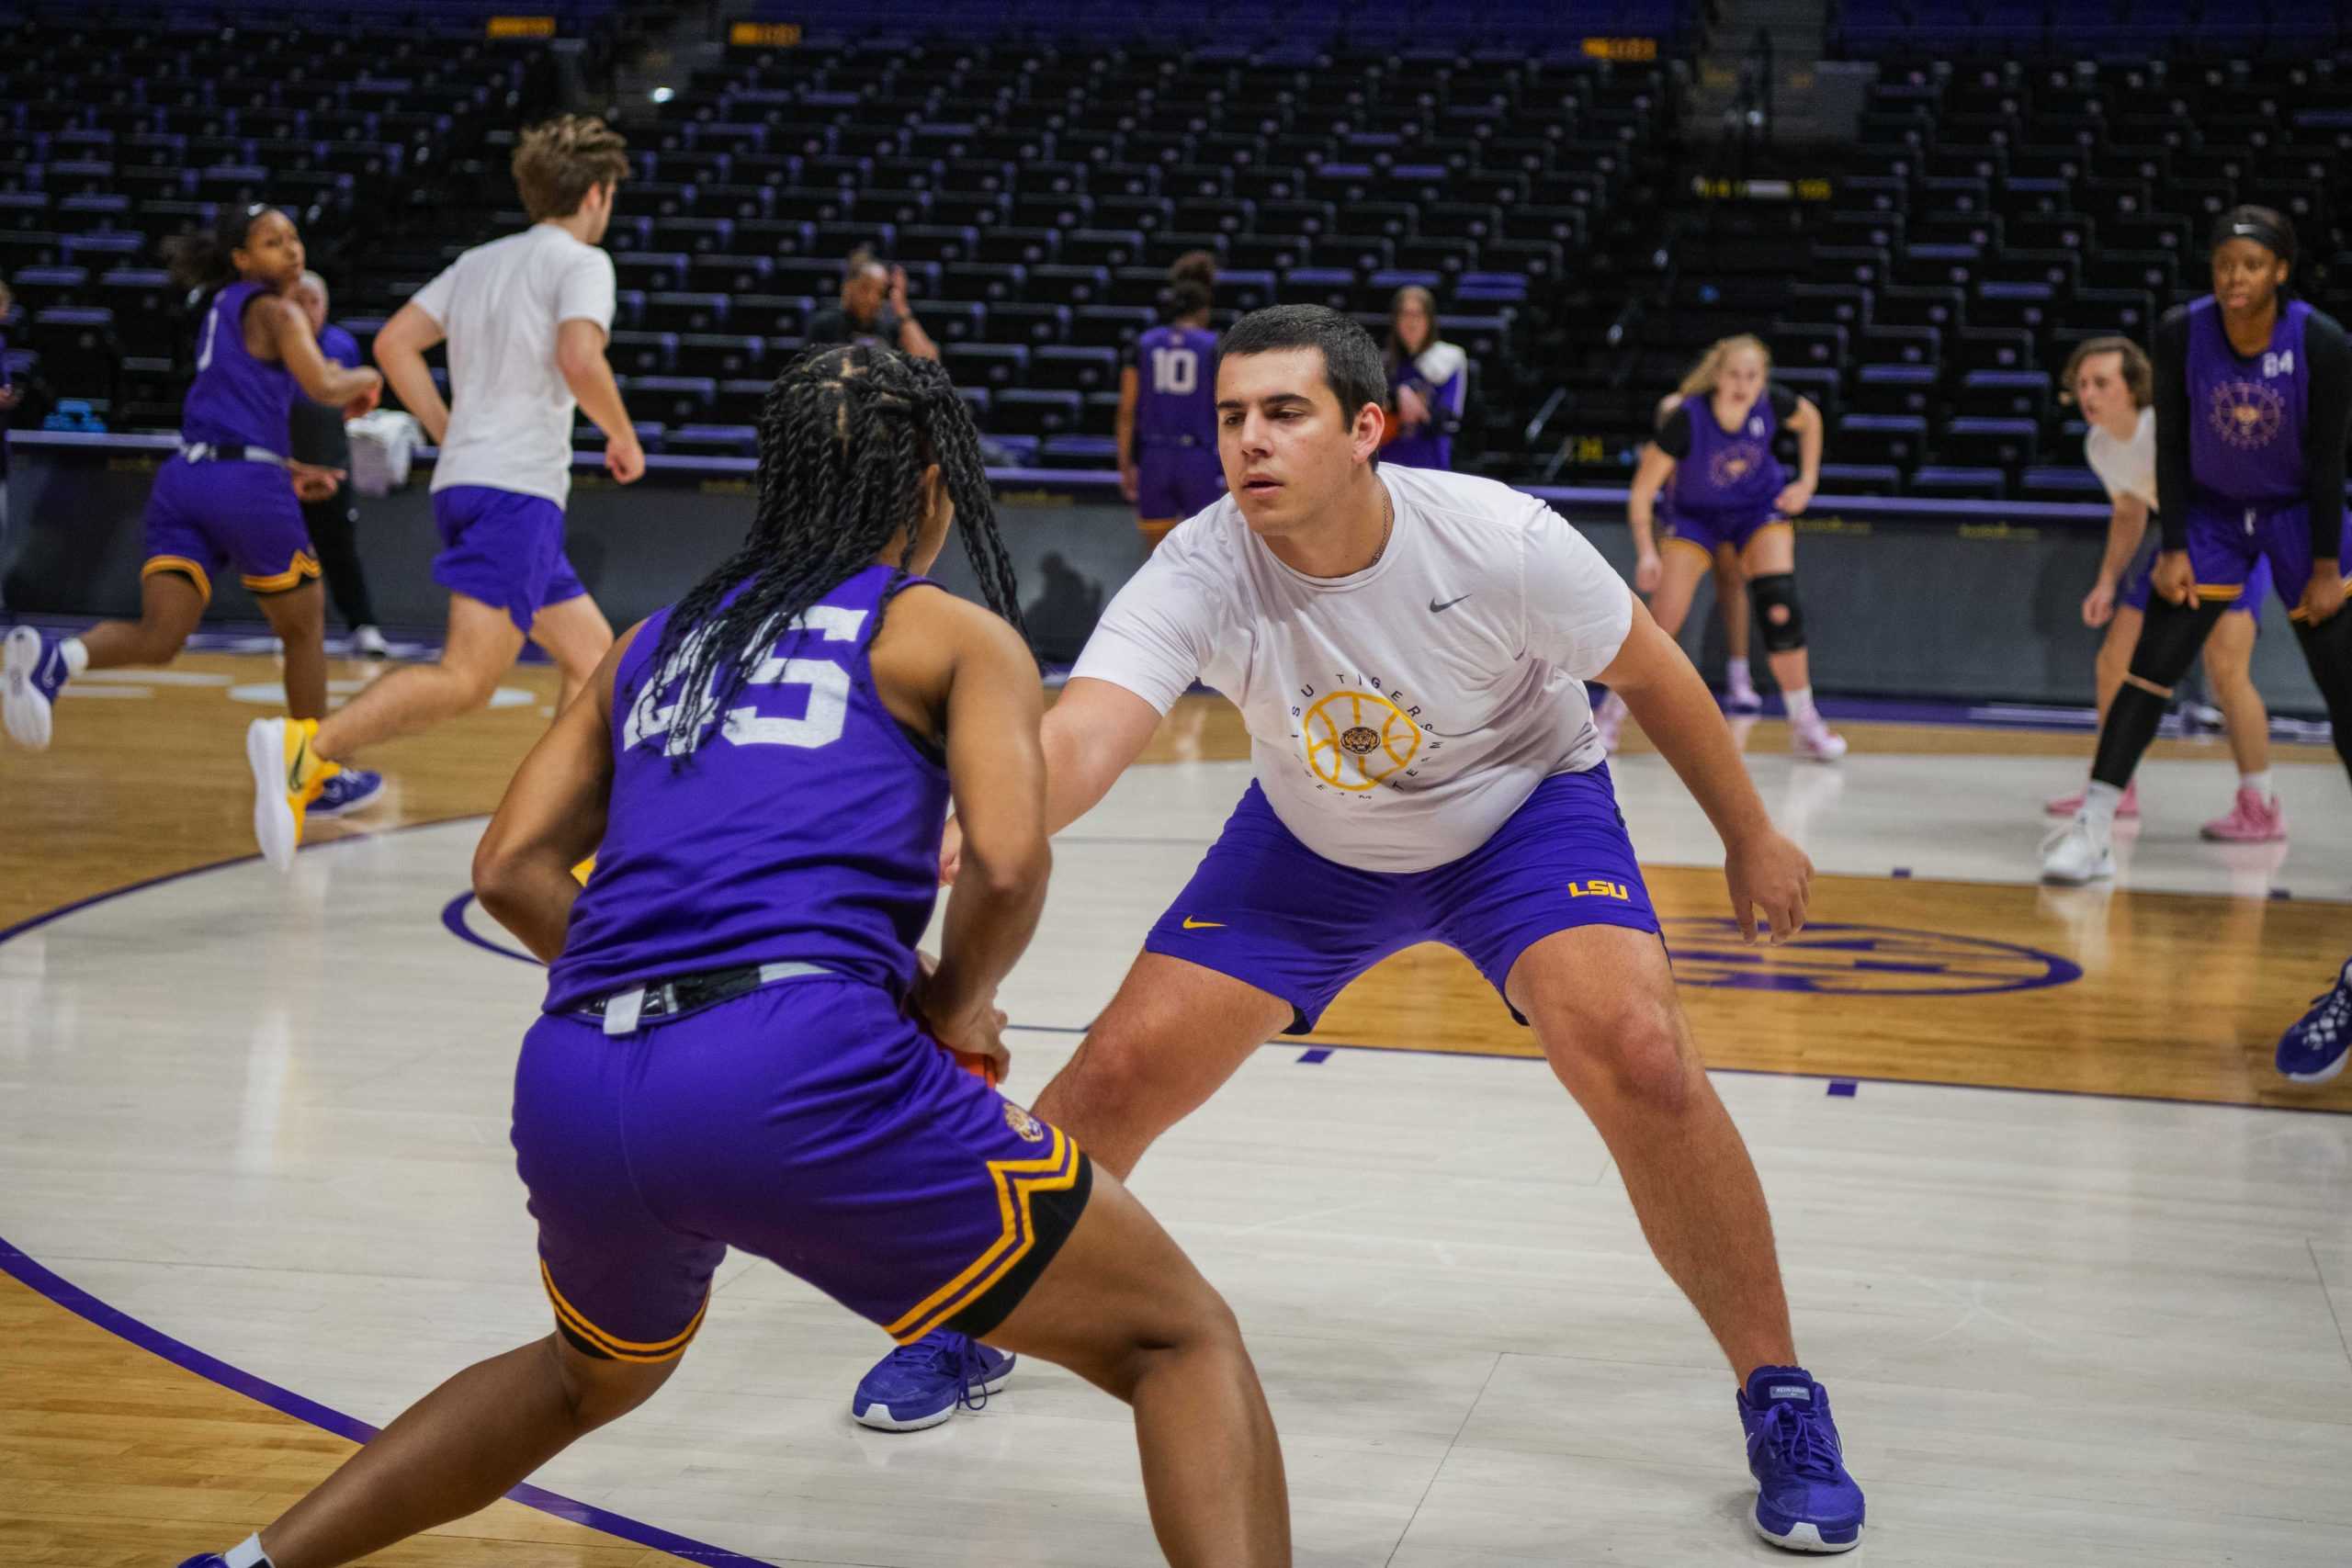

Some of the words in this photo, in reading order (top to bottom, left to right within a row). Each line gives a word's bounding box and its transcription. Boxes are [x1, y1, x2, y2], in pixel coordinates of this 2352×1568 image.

[1152, 347, 1198, 394] 10
[623, 604, 869, 757] 45
[1335, 673, 1434, 732] TIGERS
[1567, 880, 1629, 900] LSU
